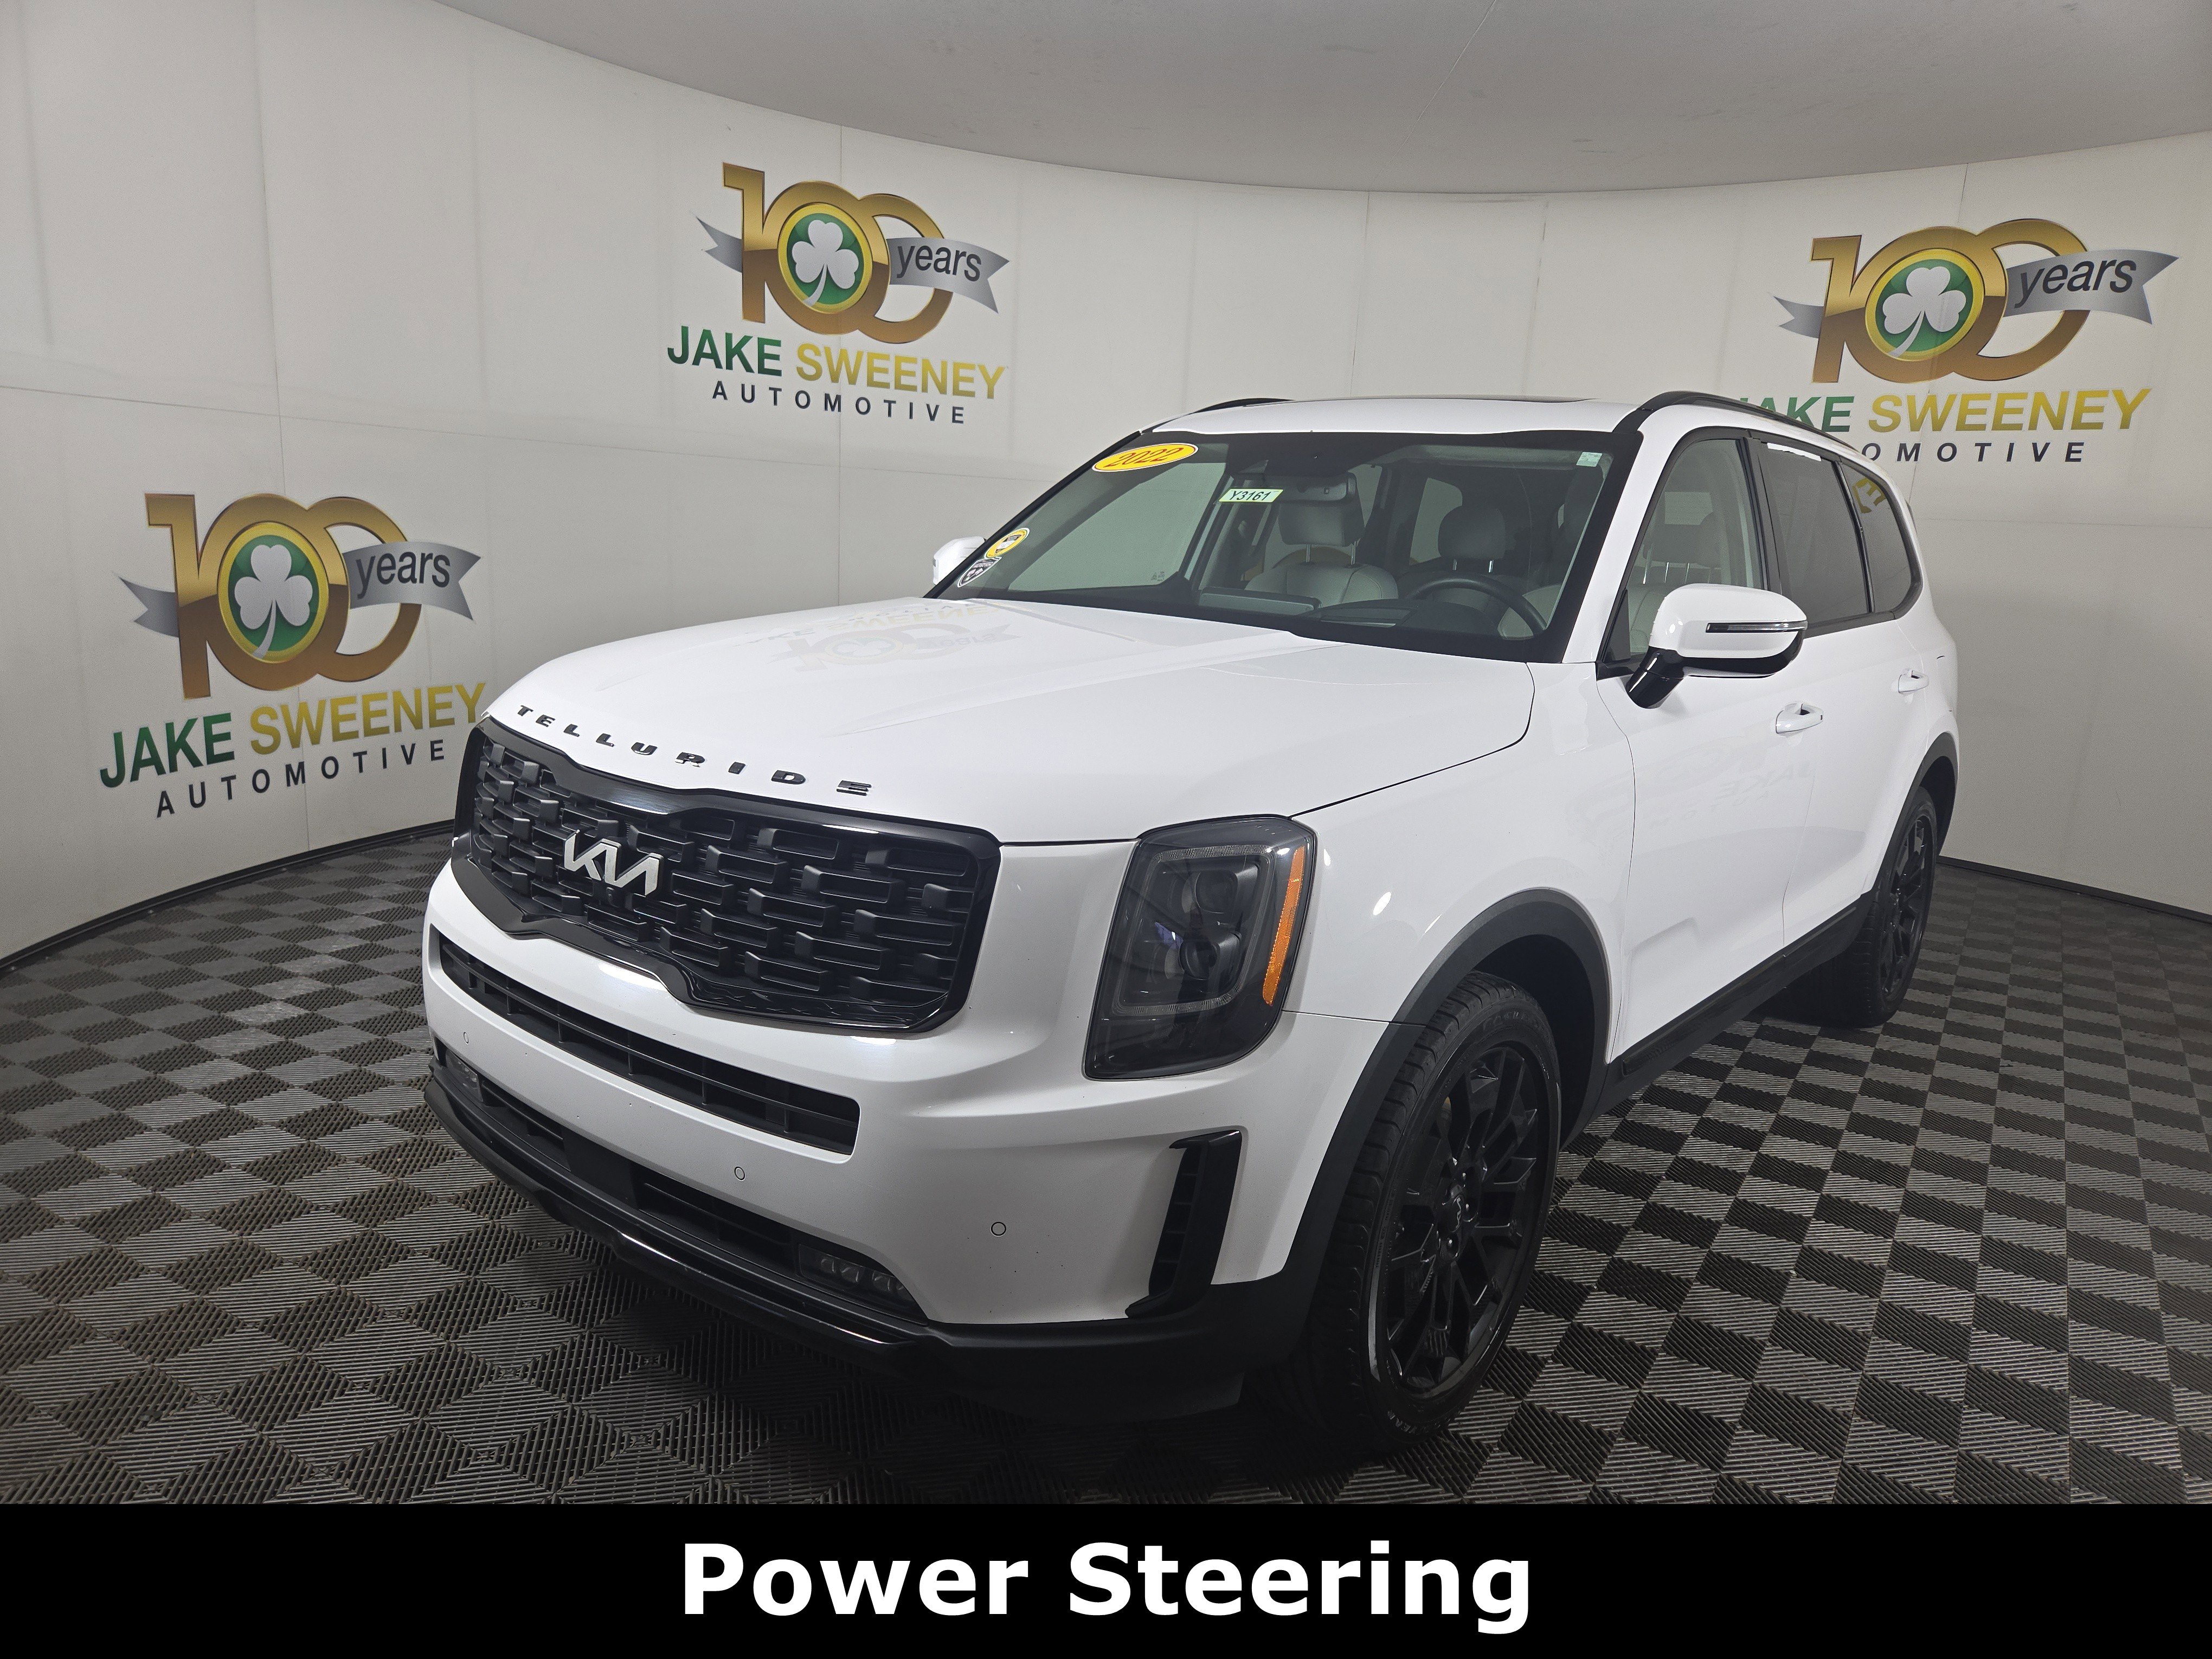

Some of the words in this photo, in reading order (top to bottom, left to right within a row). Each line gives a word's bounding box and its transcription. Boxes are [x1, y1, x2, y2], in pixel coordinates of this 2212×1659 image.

[723, 162, 953, 344] 100
[896, 243, 982, 282] years
[2014, 254, 2137, 309] years
[1811, 218, 2091, 384] 100
[667, 325, 782, 377] JAKE
[796, 343, 1005, 400] SWEENEY
[712, 380, 964, 424] AUTOMOTIVE
[1740, 396, 1855, 432] KE
[1868, 388, 2152, 433] SWEENEY
[1103, 447, 1185, 468] 2022
[1862, 442, 2086, 463] OMOTIVE
[1229, 490, 1272, 501] Y3161
[145, 492, 422, 700] 100
[355, 551, 451, 599] years
[99, 712, 235, 788] JAKE
[249, 683, 486, 755] SWEENEY
[517, 704, 872, 796] TELLURIDE
[156, 739, 445, 818] AUTOMOTIVE
[564, 829, 664, 897] KIA
